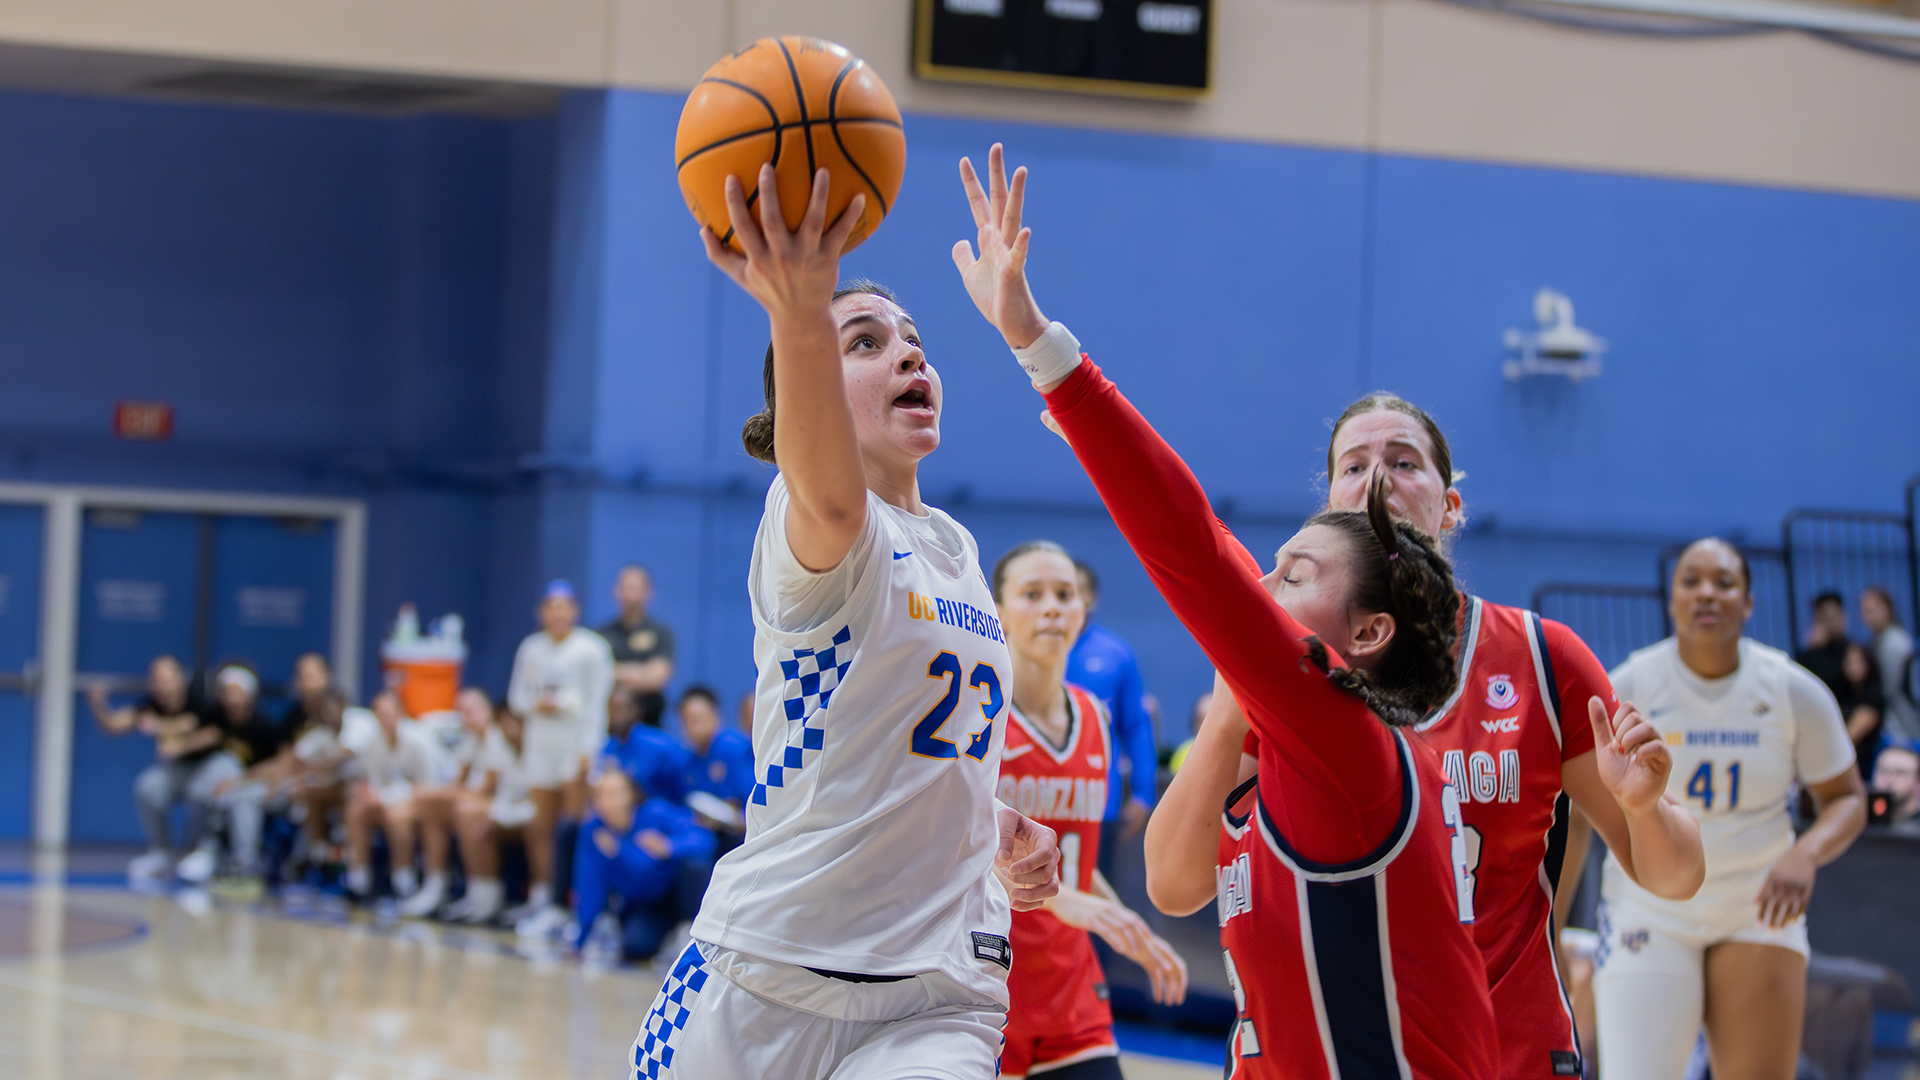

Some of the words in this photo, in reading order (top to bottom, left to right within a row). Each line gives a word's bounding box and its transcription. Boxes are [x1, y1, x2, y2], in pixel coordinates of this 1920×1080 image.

[908, 591, 935, 621] UC
[934, 597, 1005, 646] RIVERSIDE
[908, 649, 1005, 763] 23
[1480, 716, 1520, 734] WCC
[1685, 759, 1742, 810] 41
